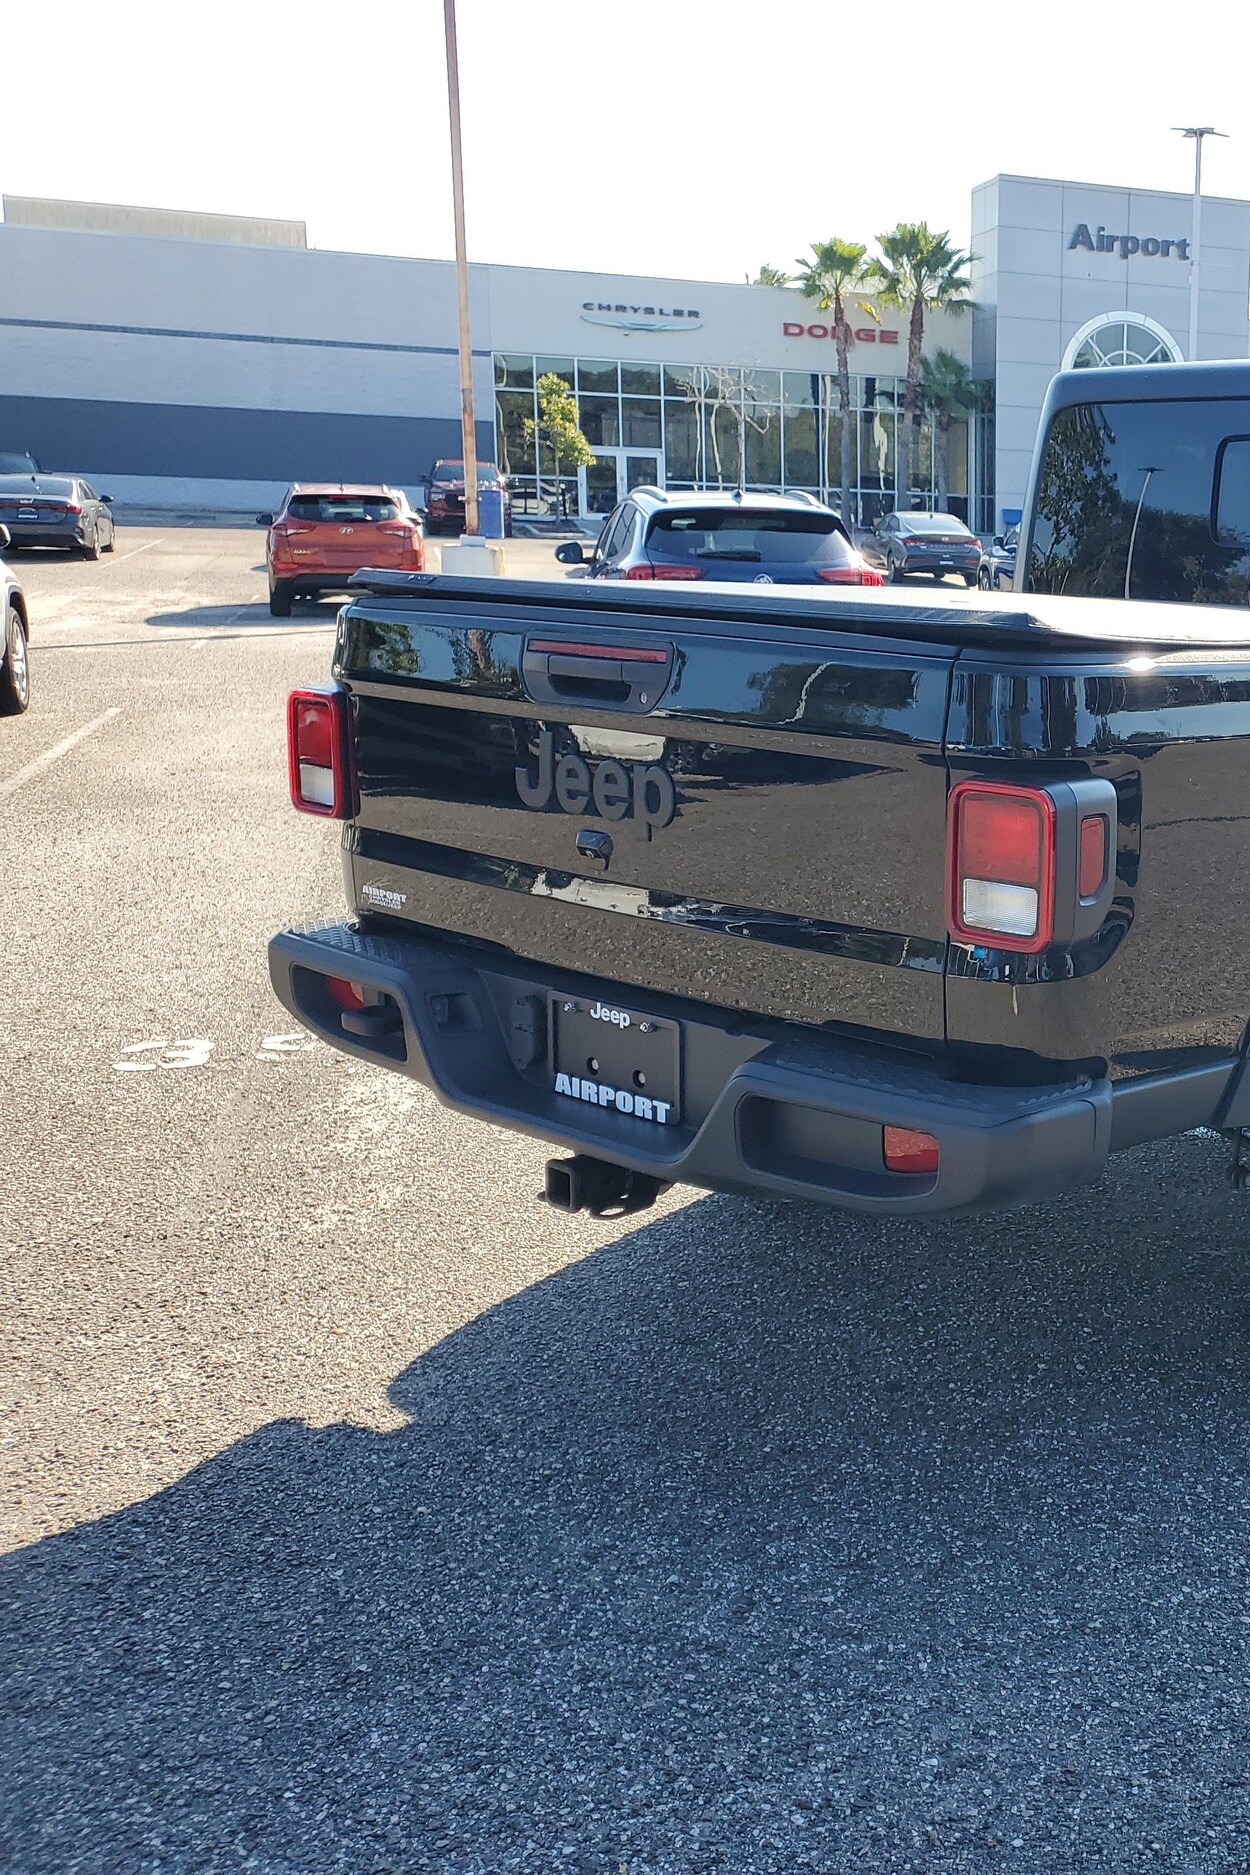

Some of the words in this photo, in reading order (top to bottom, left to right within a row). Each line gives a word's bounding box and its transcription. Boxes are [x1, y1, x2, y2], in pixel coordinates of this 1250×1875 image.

[1067, 223, 1190, 261] Airport
[582, 302, 700, 319] CHRYSLER
[515, 731, 675, 842] Jeep
[362, 884, 408, 903] AIRPORT
[590, 1002, 631, 1029] Jeep
[554, 1072, 671, 1124] AIRPORT
